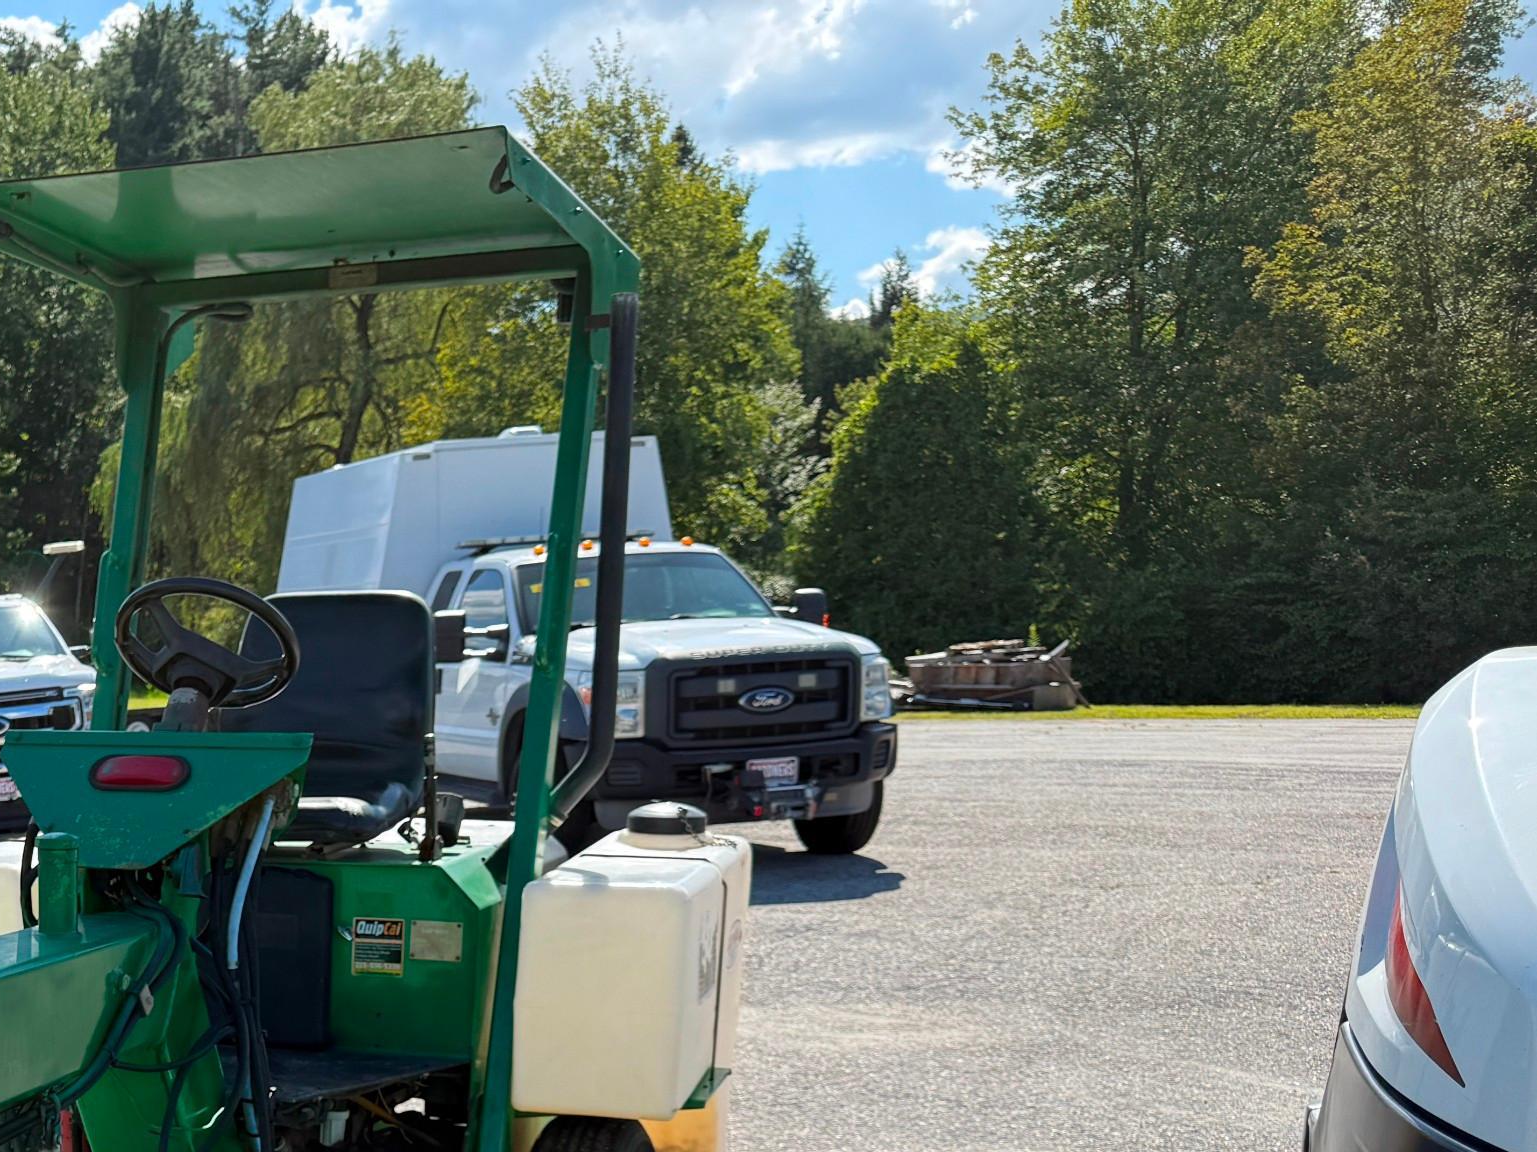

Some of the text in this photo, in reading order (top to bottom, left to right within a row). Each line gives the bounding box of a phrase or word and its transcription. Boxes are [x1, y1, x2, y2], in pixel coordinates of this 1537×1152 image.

[690, 646, 762, 660] SUPER
[752, 694, 785, 708] Ford
[356, 921, 401, 936] QuipCal
